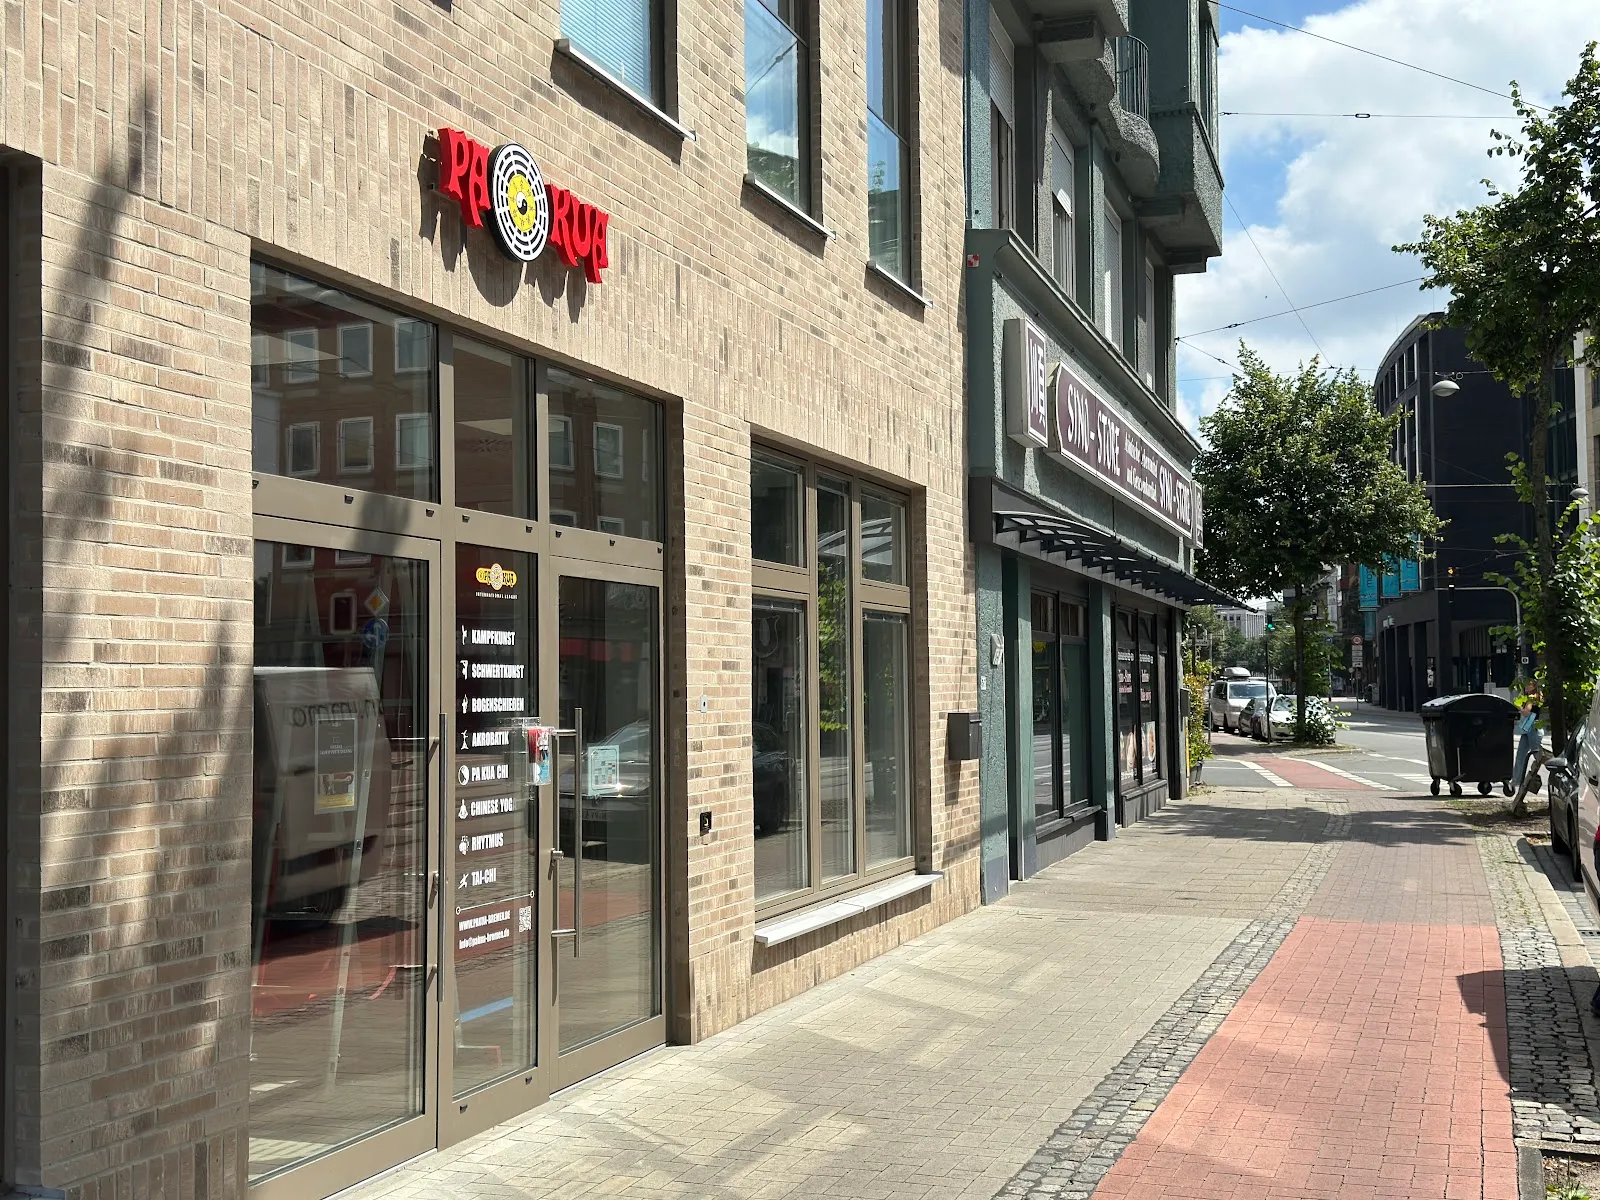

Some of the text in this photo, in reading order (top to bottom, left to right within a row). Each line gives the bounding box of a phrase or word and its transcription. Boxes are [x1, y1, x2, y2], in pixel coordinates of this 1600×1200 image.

[438, 128, 609, 283] PA KUA
[472, 629, 516, 646] KAMPFKUNST
[472, 663, 525, 680] SCHWERTKUNST
[472, 731, 510, 748] AKROBATIK
[472, 764, 509, 782] PA KUA CHI
[470, 799, 499, 817] CHINESE
[471, 832, 504, 851] RHYTMUS
[471, 868, 497, 887] TAI-CHI
